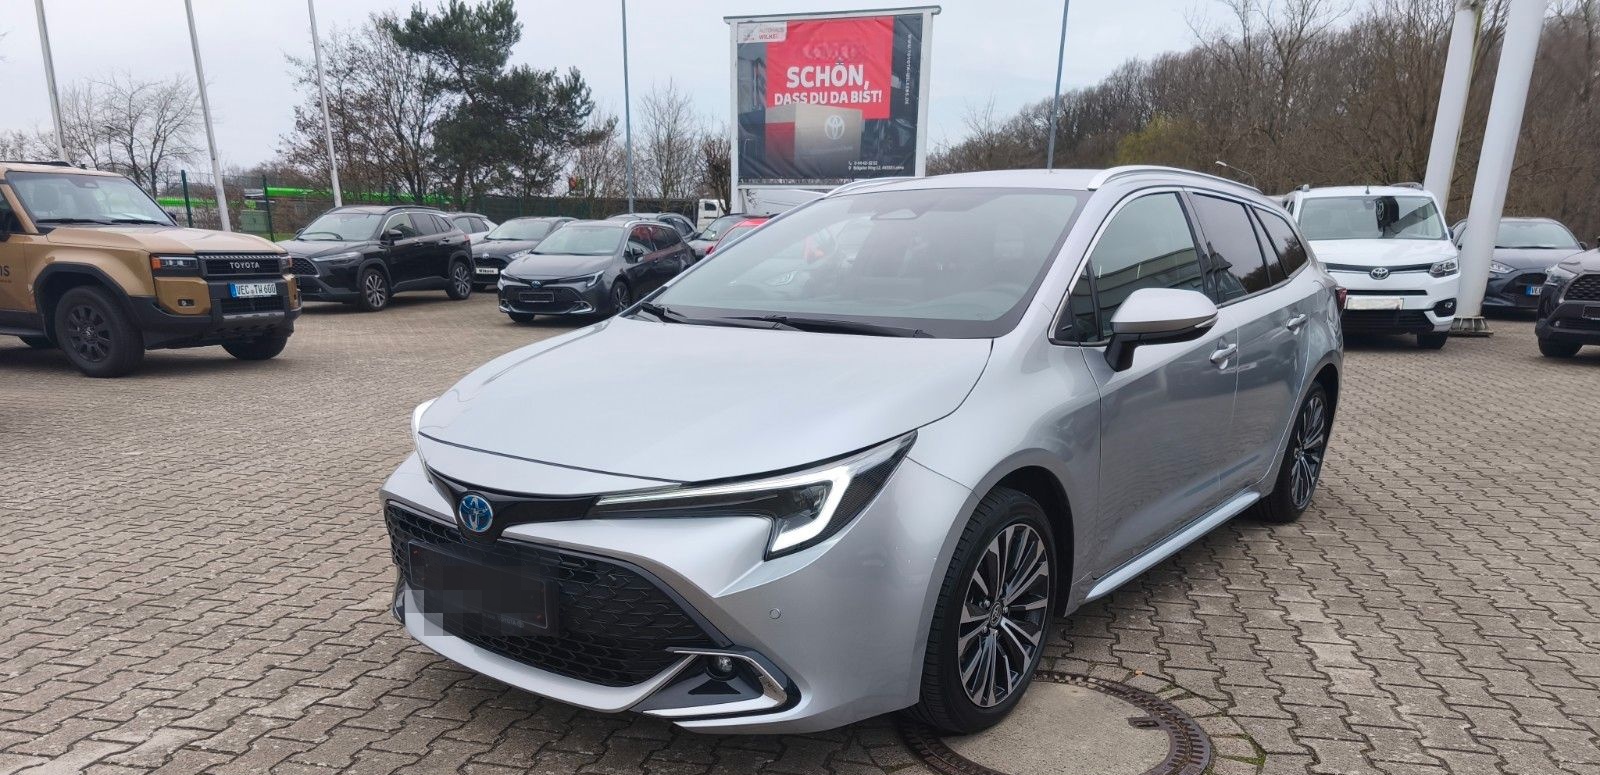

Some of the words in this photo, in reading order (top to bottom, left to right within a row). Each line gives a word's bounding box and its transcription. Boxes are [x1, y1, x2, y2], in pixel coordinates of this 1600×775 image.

[786, 62, 870, 90] SCHÖN,
[774, 92, 808, 105] DASS
[810, 91, 828, 105] DU
[830, 91, 849, 104] DA
[850, 90, 882, 103] BIST!
[236, 285, 250, 295] VEC
